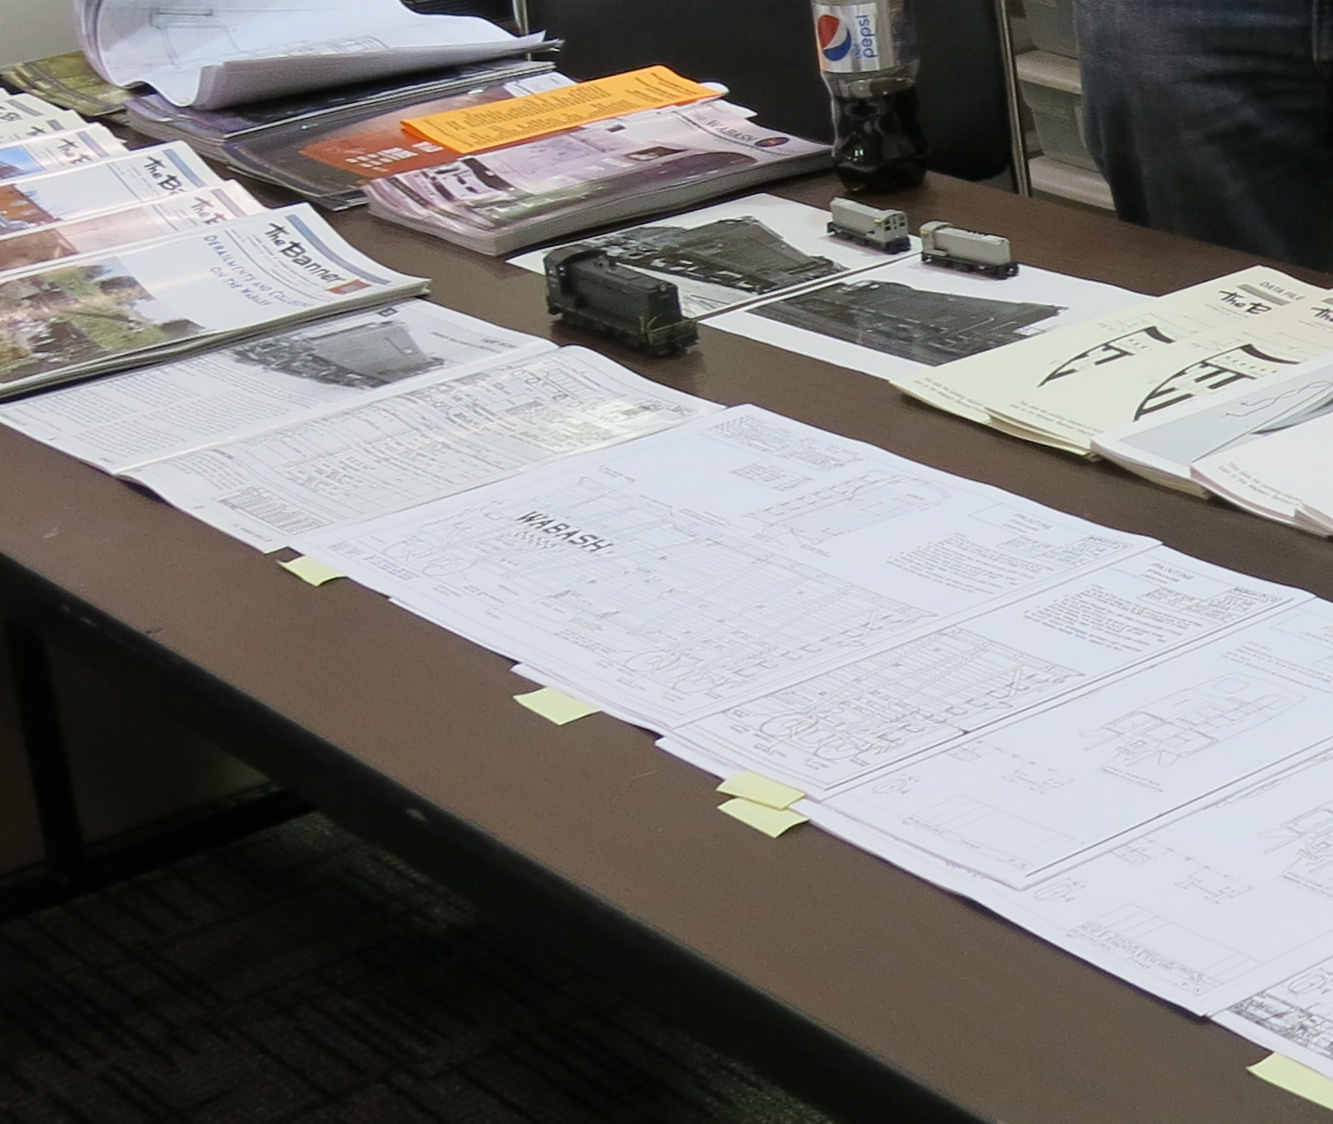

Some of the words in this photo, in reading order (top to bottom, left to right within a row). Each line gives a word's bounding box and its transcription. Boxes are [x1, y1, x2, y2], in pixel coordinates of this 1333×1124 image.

[858, 14, 878, 59] pepsi
[203, 234, 257, 282] DERAILMENTS
[264, 222, 290, 247] The
[281, 240, 347, 283] Banner
[1218, 289, 1244, 308] The
[1259, 281, 1284, 295] DATA
[1283, 290, 1306, 302] FILE
[516, 510, 614, 553] WABASH
